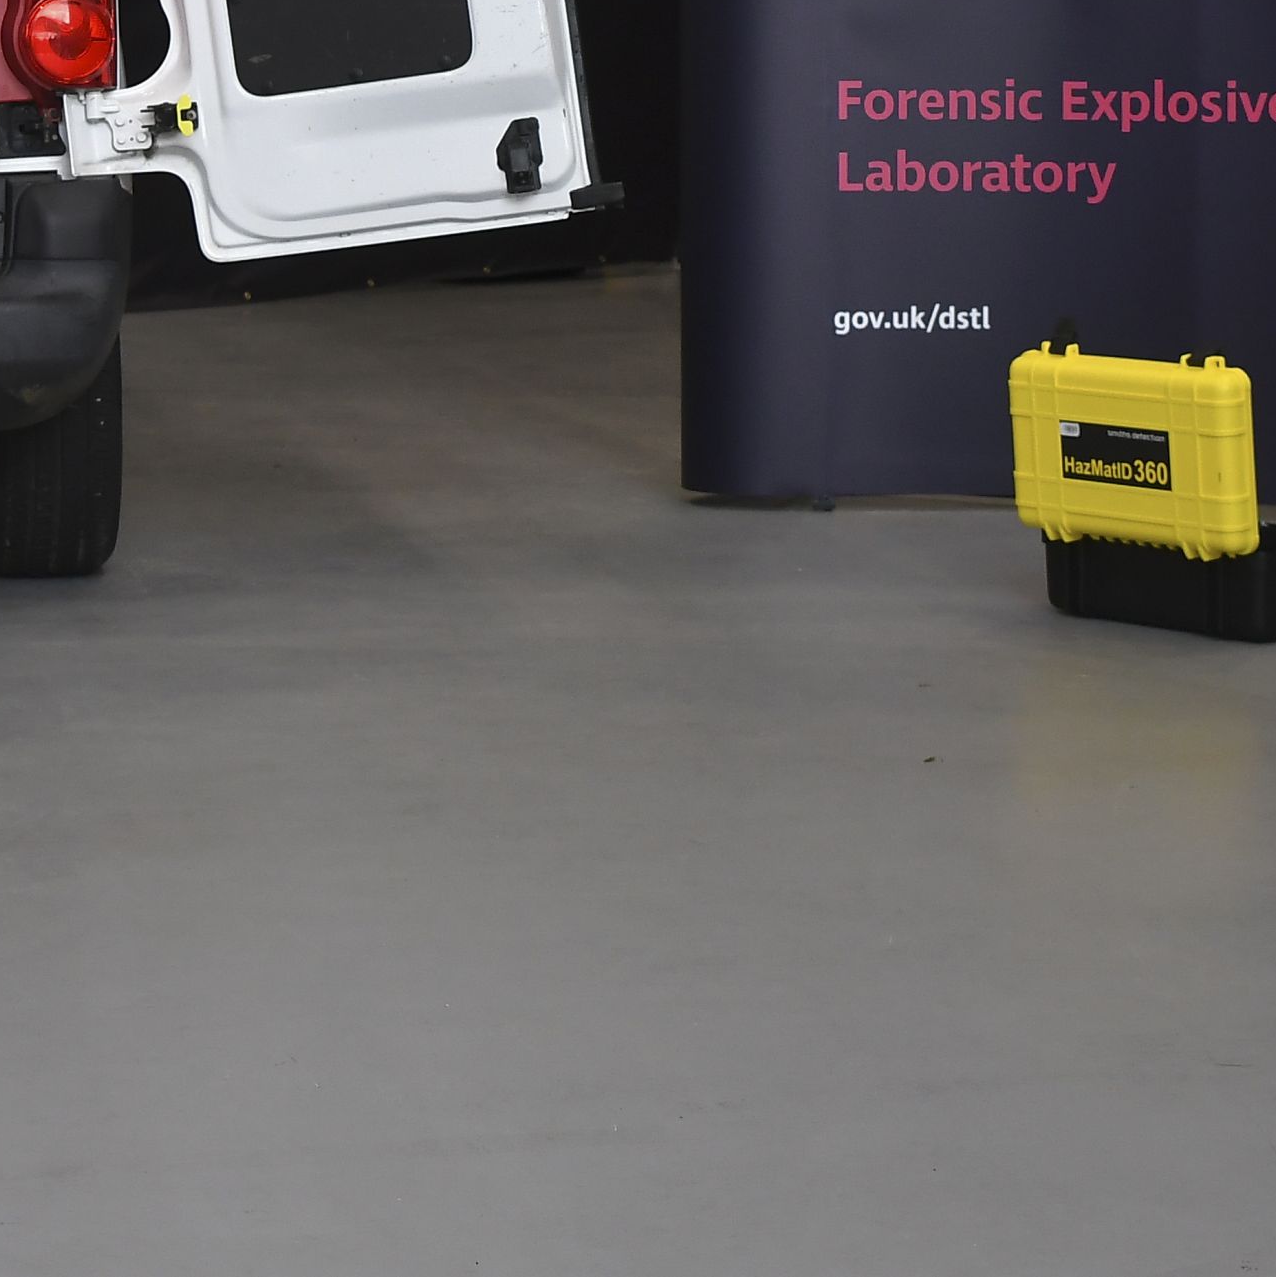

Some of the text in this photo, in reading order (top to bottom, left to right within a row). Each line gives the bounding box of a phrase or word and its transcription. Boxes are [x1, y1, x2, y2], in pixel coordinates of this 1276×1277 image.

[838, 78, 1044, 121] Forensic
[838, 149, 1117, 204] Laboratory
[833, 302, 991, 335] gov.uk/dstl
[1064, 455, 1168, 485] HazMatID 360
